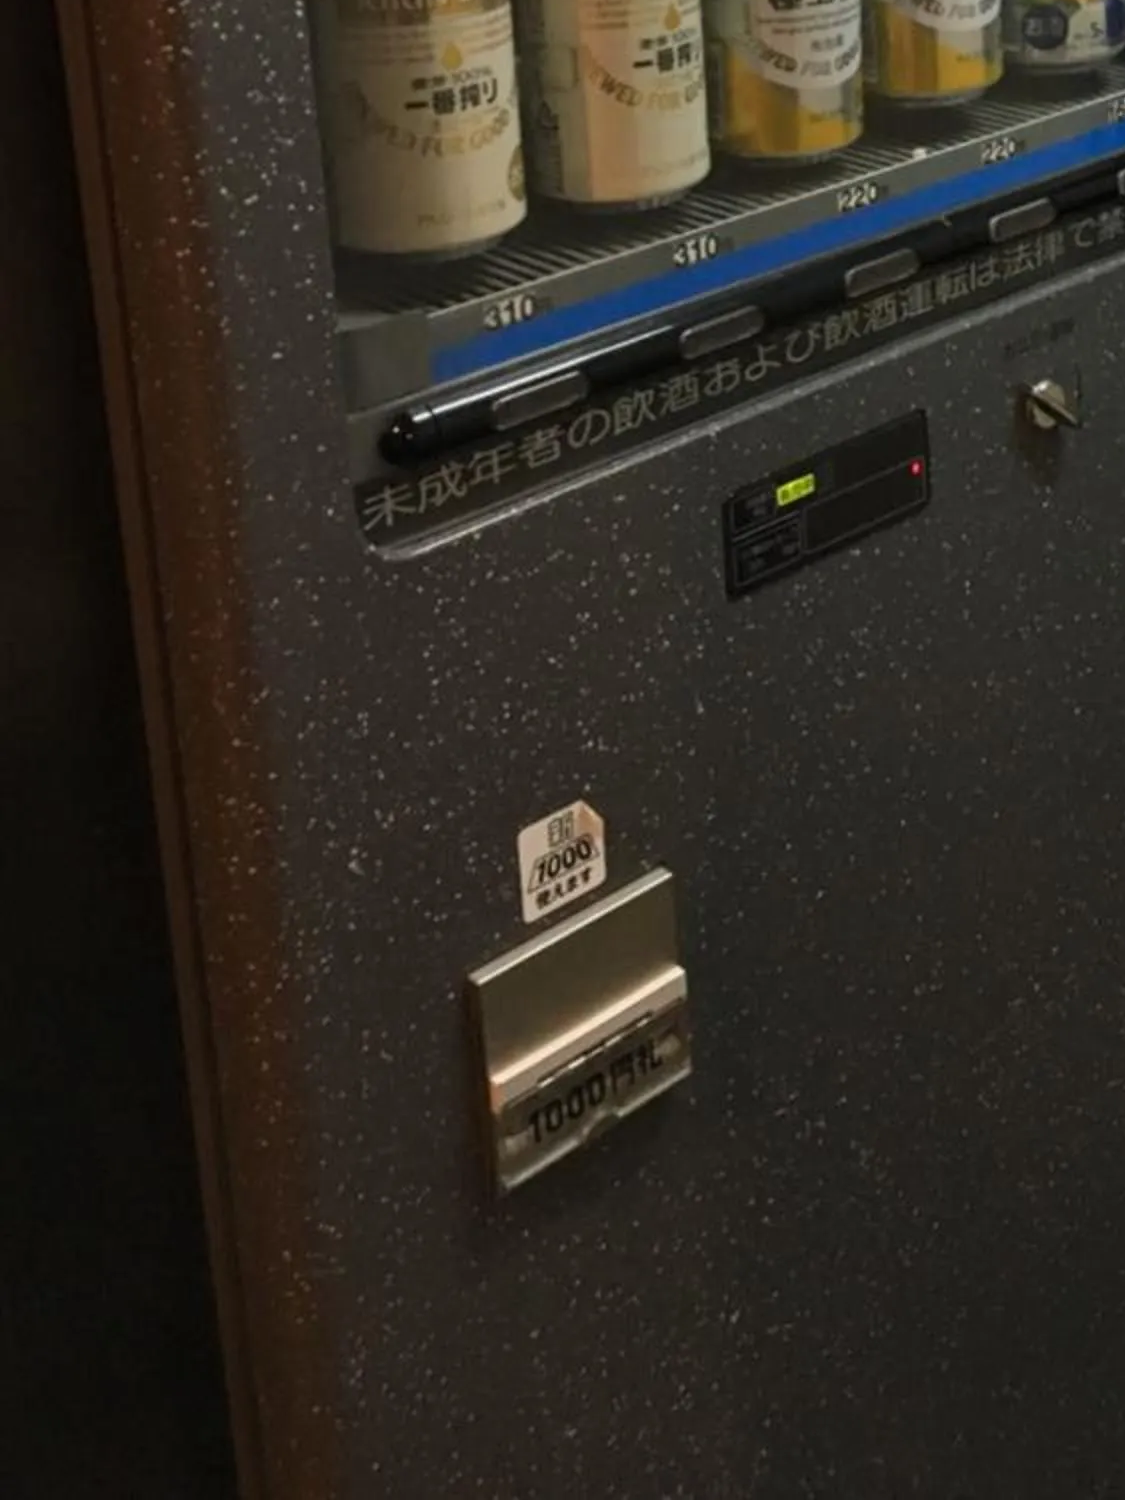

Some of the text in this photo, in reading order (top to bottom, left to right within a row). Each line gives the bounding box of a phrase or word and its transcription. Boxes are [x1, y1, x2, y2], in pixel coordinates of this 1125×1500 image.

[404, 77, 498, 116] 一番搾り
[538, 839, 592, 883] 1000
